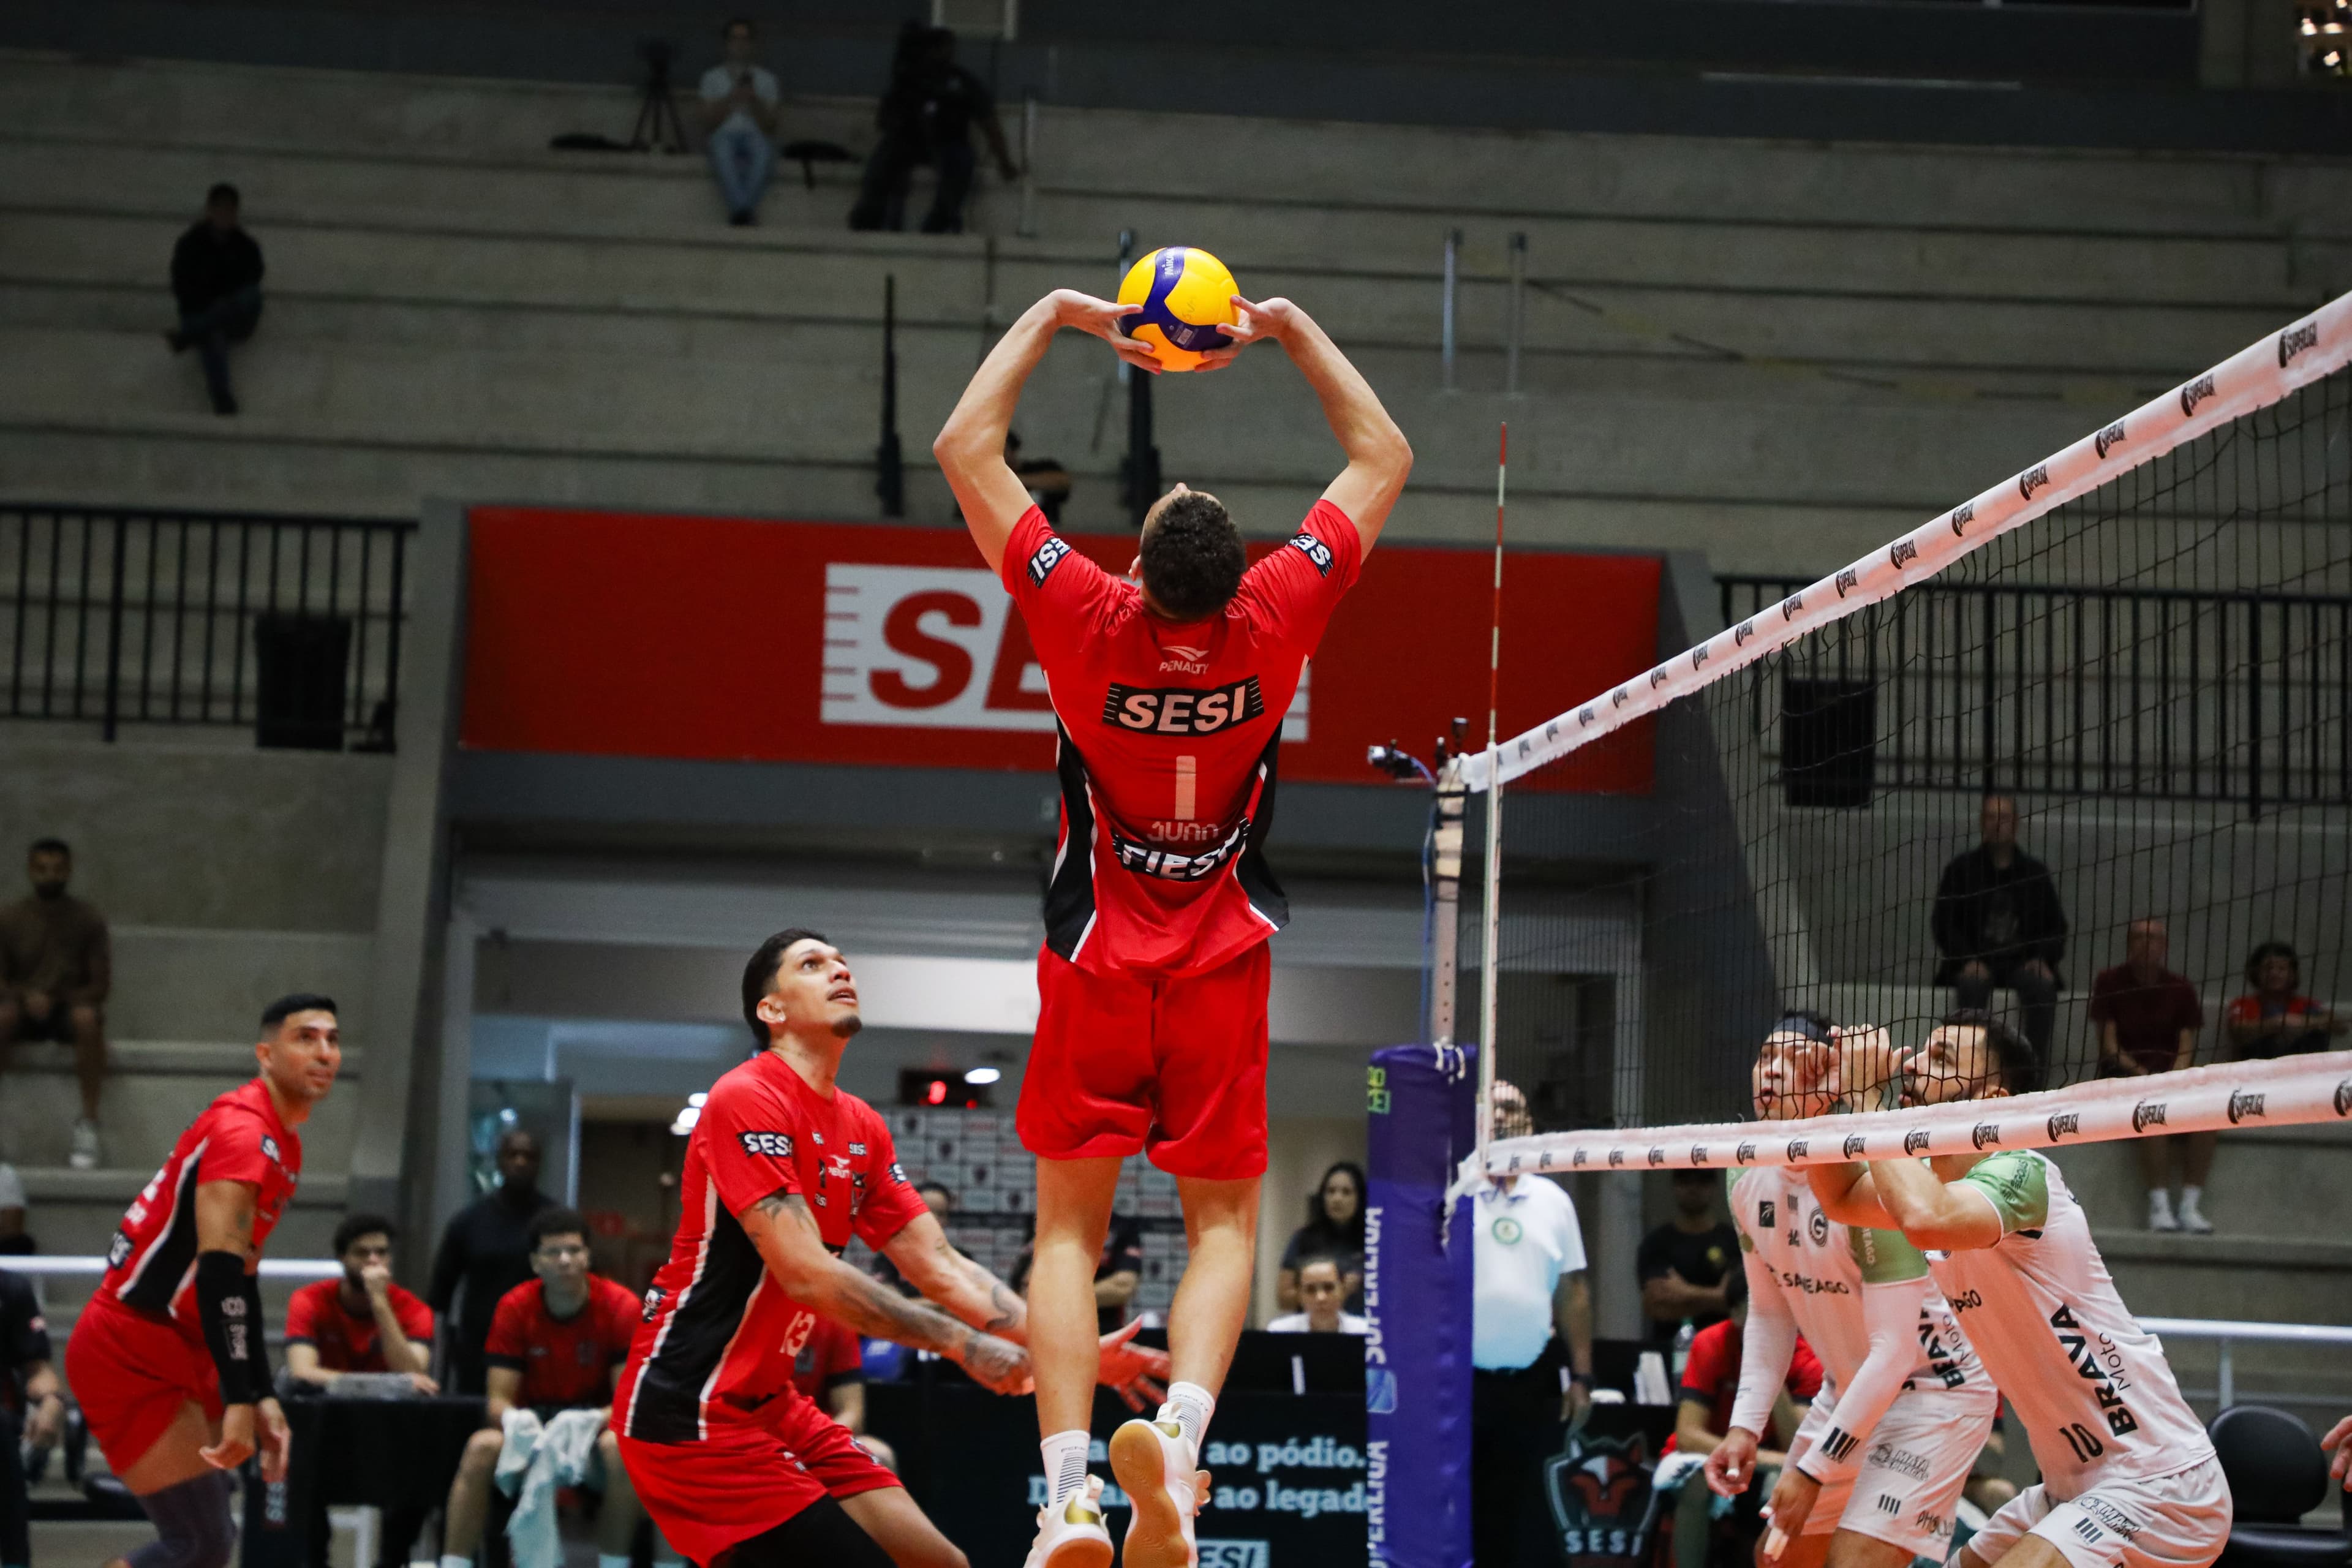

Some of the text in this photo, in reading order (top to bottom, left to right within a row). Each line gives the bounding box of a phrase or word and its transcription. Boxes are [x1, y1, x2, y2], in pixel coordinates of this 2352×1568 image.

[1031, 538, 1071, 579] ESI
[869, 589, 1050, 712] SE
[1159, 660, 1209, 674] PENALTY
[1118, 685, 1248, 733] SESI
[1175, 755, 1196, 820] 1
[2050, 1303, 2138, 1437] BRAVA
[1206, 1436, 1365, 1472] ao pódio.
[2059, 1423, 2103, 1463] 10
[1214, 1479, 1367, 1518] ao legad
[1197, 1547, 1259, 1568] ESI
